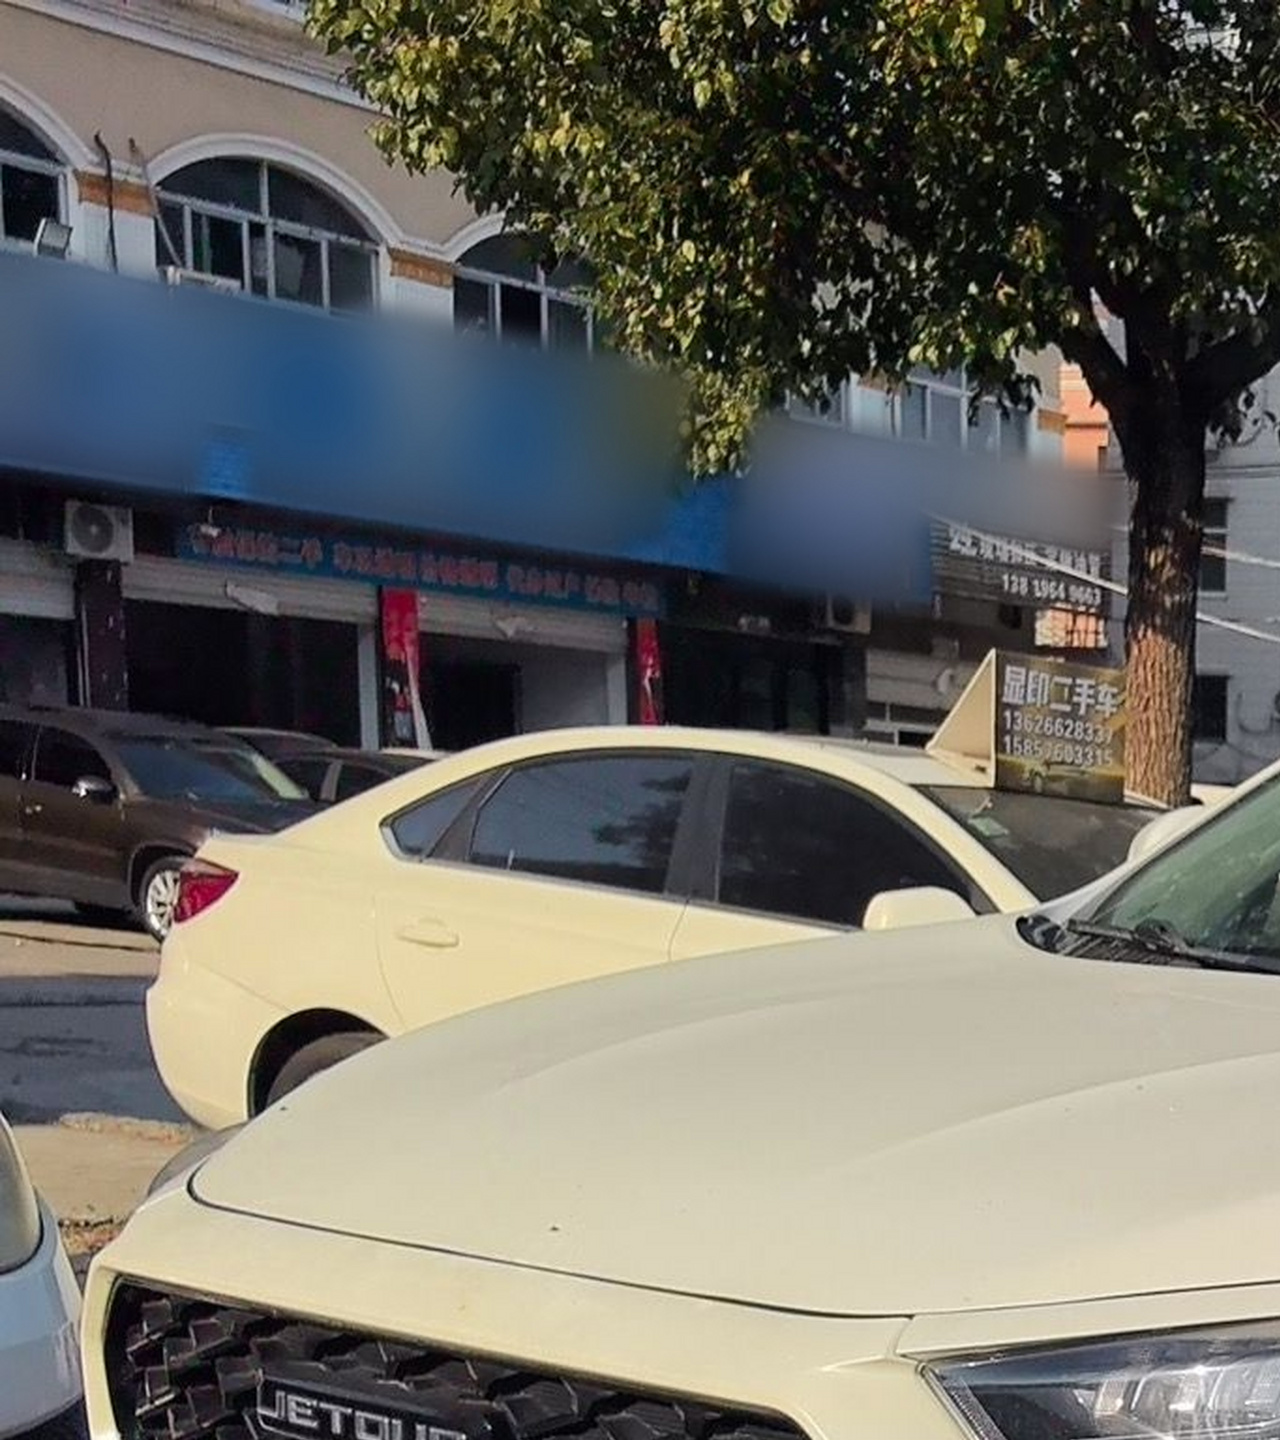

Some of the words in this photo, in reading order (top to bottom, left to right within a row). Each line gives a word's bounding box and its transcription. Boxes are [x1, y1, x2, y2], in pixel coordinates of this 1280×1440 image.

[1002, 664, 1119, 718] 显印二手车
